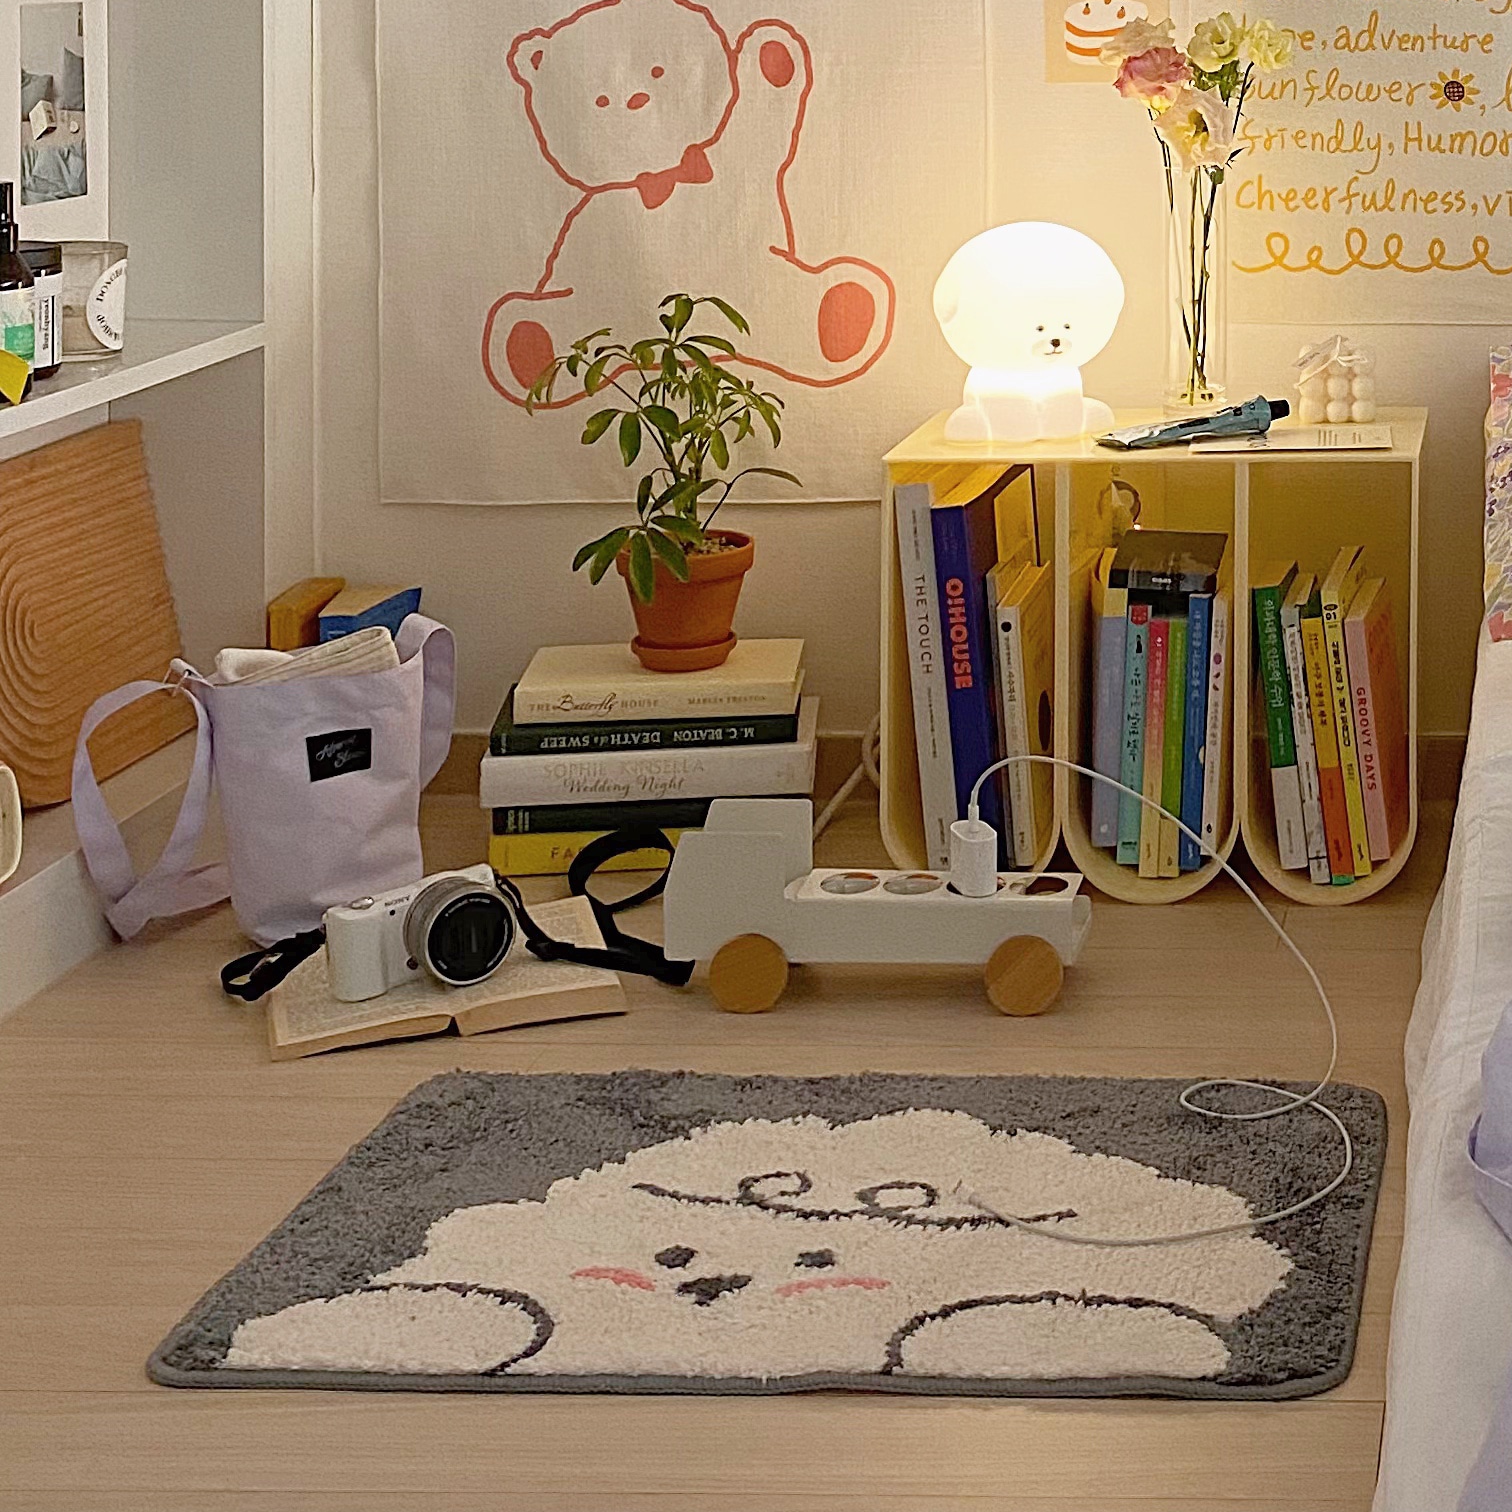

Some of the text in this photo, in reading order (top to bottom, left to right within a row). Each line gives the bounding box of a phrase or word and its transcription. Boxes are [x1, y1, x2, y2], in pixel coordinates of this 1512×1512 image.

[913, 573, 929, 611] THE
[917, 614, 934, 675] TOUCH
[552, 691, 618, 718] Butterfly
[621, 699, 660, 709] HOUSE
[540, 735, 590, 749] SWEEP
[610, 731, 661, 746] DEATH
[673, 728, 723, 743] BEATON
[740, 727, 756, 739] M.
[1356, 687, 1378, 791] GROOVY DAYS
[563, 775, 686, 799] Wedding Night
